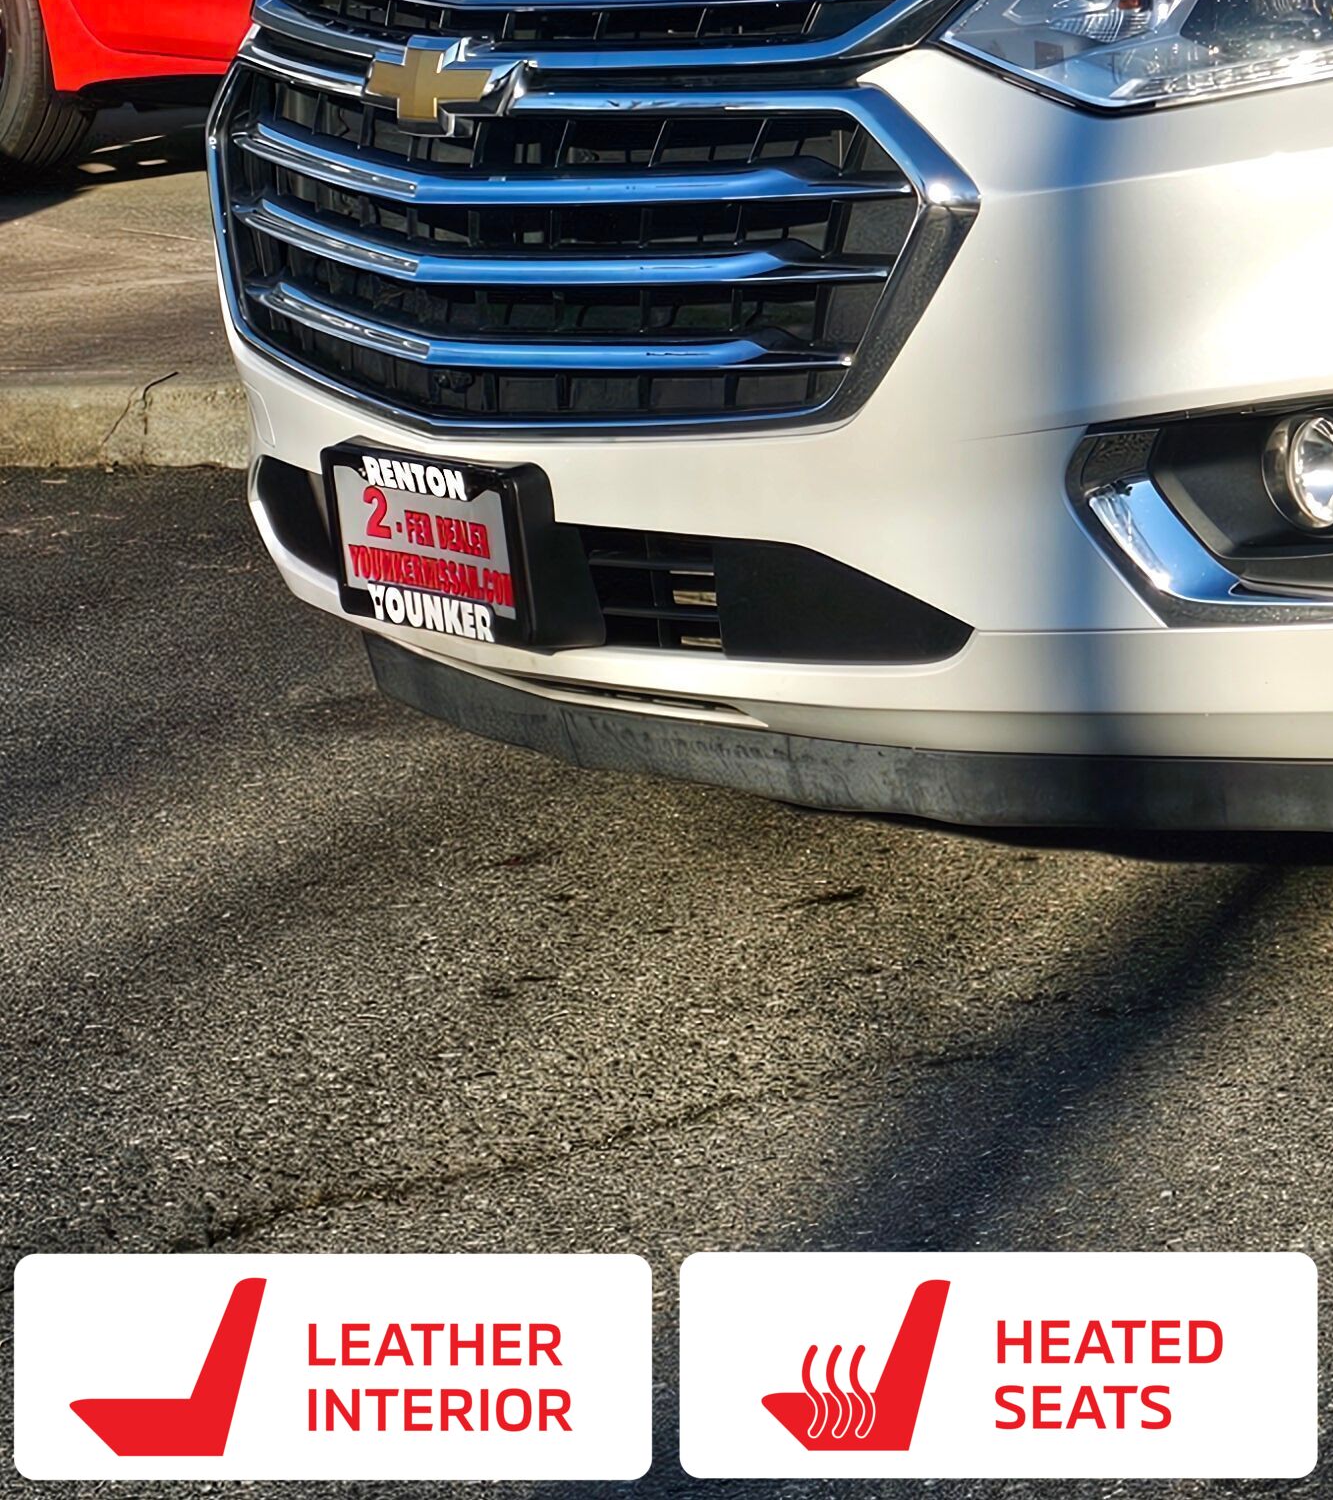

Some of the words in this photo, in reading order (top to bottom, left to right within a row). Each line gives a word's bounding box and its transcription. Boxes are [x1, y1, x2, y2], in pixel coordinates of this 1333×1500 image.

[362, 455, 468, 501] RENTON
[362, 485, 392, 539] 2
[366, 583, 496, 644] YOUNKER
